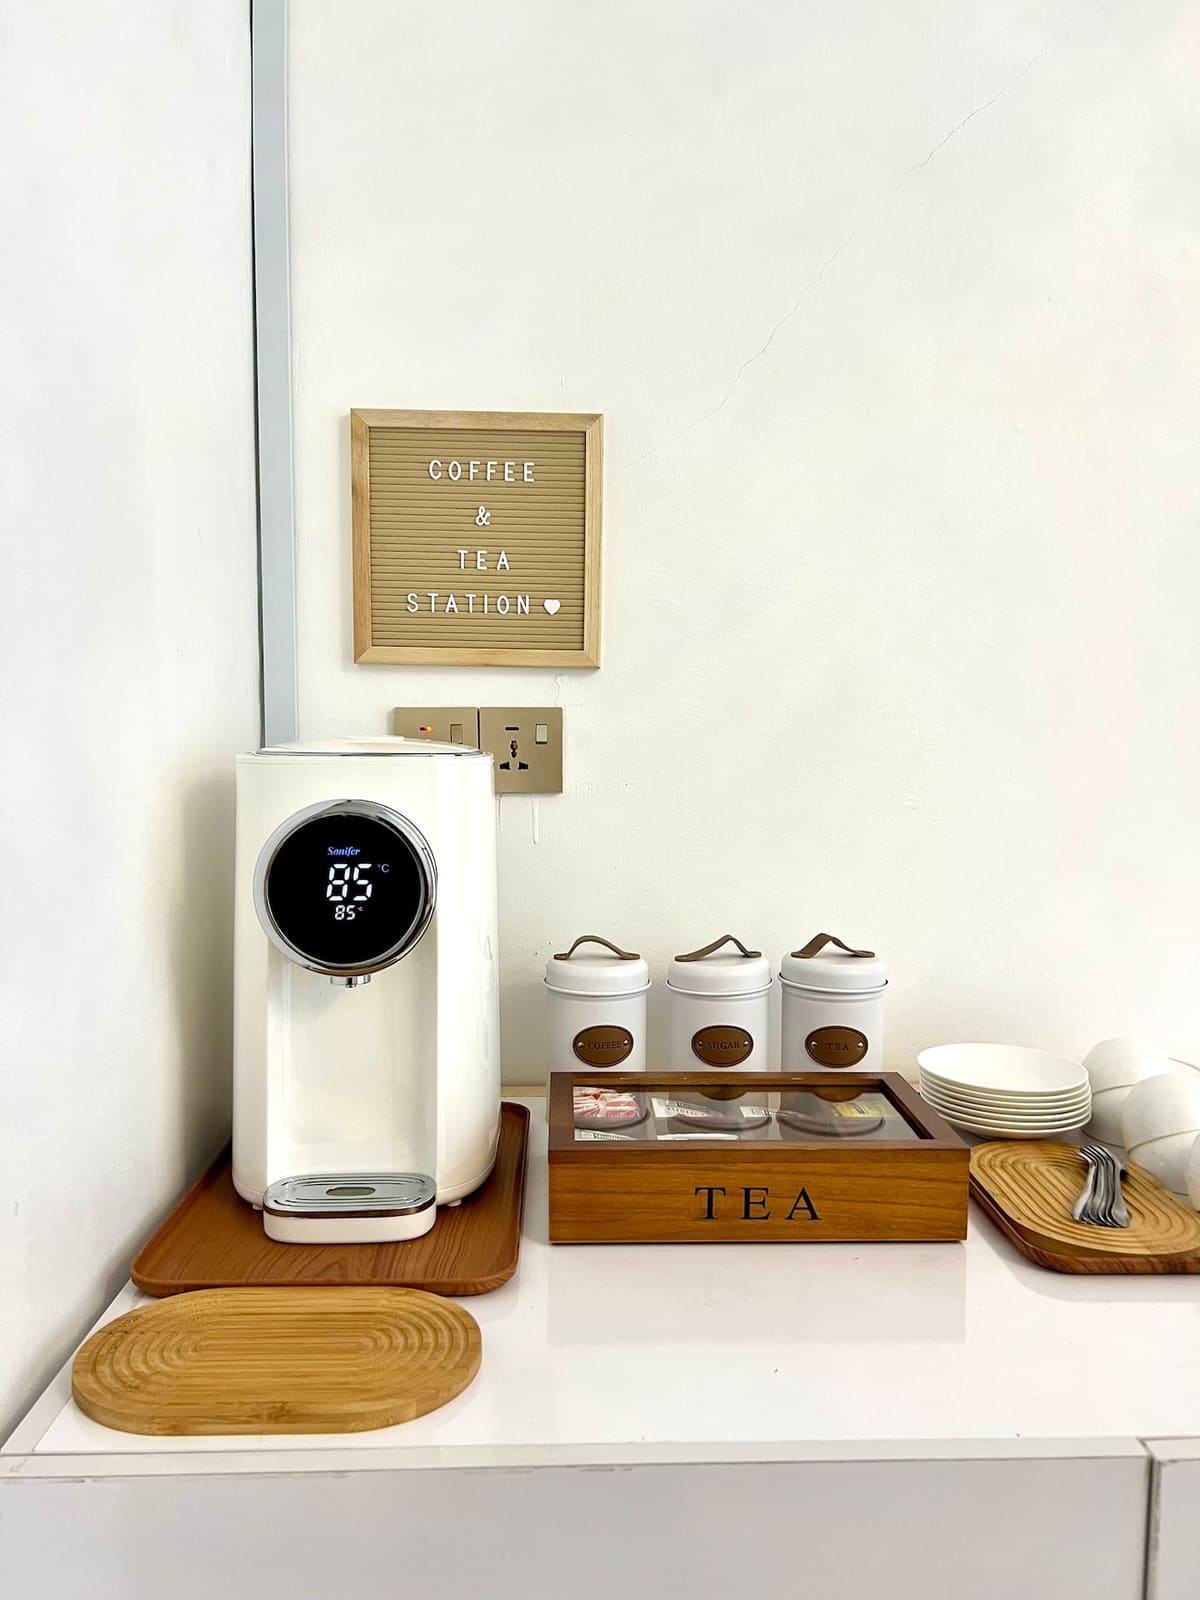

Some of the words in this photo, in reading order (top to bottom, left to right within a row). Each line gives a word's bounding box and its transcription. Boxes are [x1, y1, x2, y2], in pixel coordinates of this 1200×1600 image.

[428, 459, 535, 483] COFFEE
[475, 505, 491, 526] &
[457, 550, 511, 570] TEA
[406, 593, 530, 615] STATION
[327, 846, 361, 856] Sonifer
[326, 863, 373, 901] 85
[334, 904, 356, 920] 85
[587, 1040, 622, 1050] COFFEE
[705, 1040, 741, 1050] SUGAR
[826, 1042, 849, 1051] TEA
[694, 1186, 822, 1220] TEA
